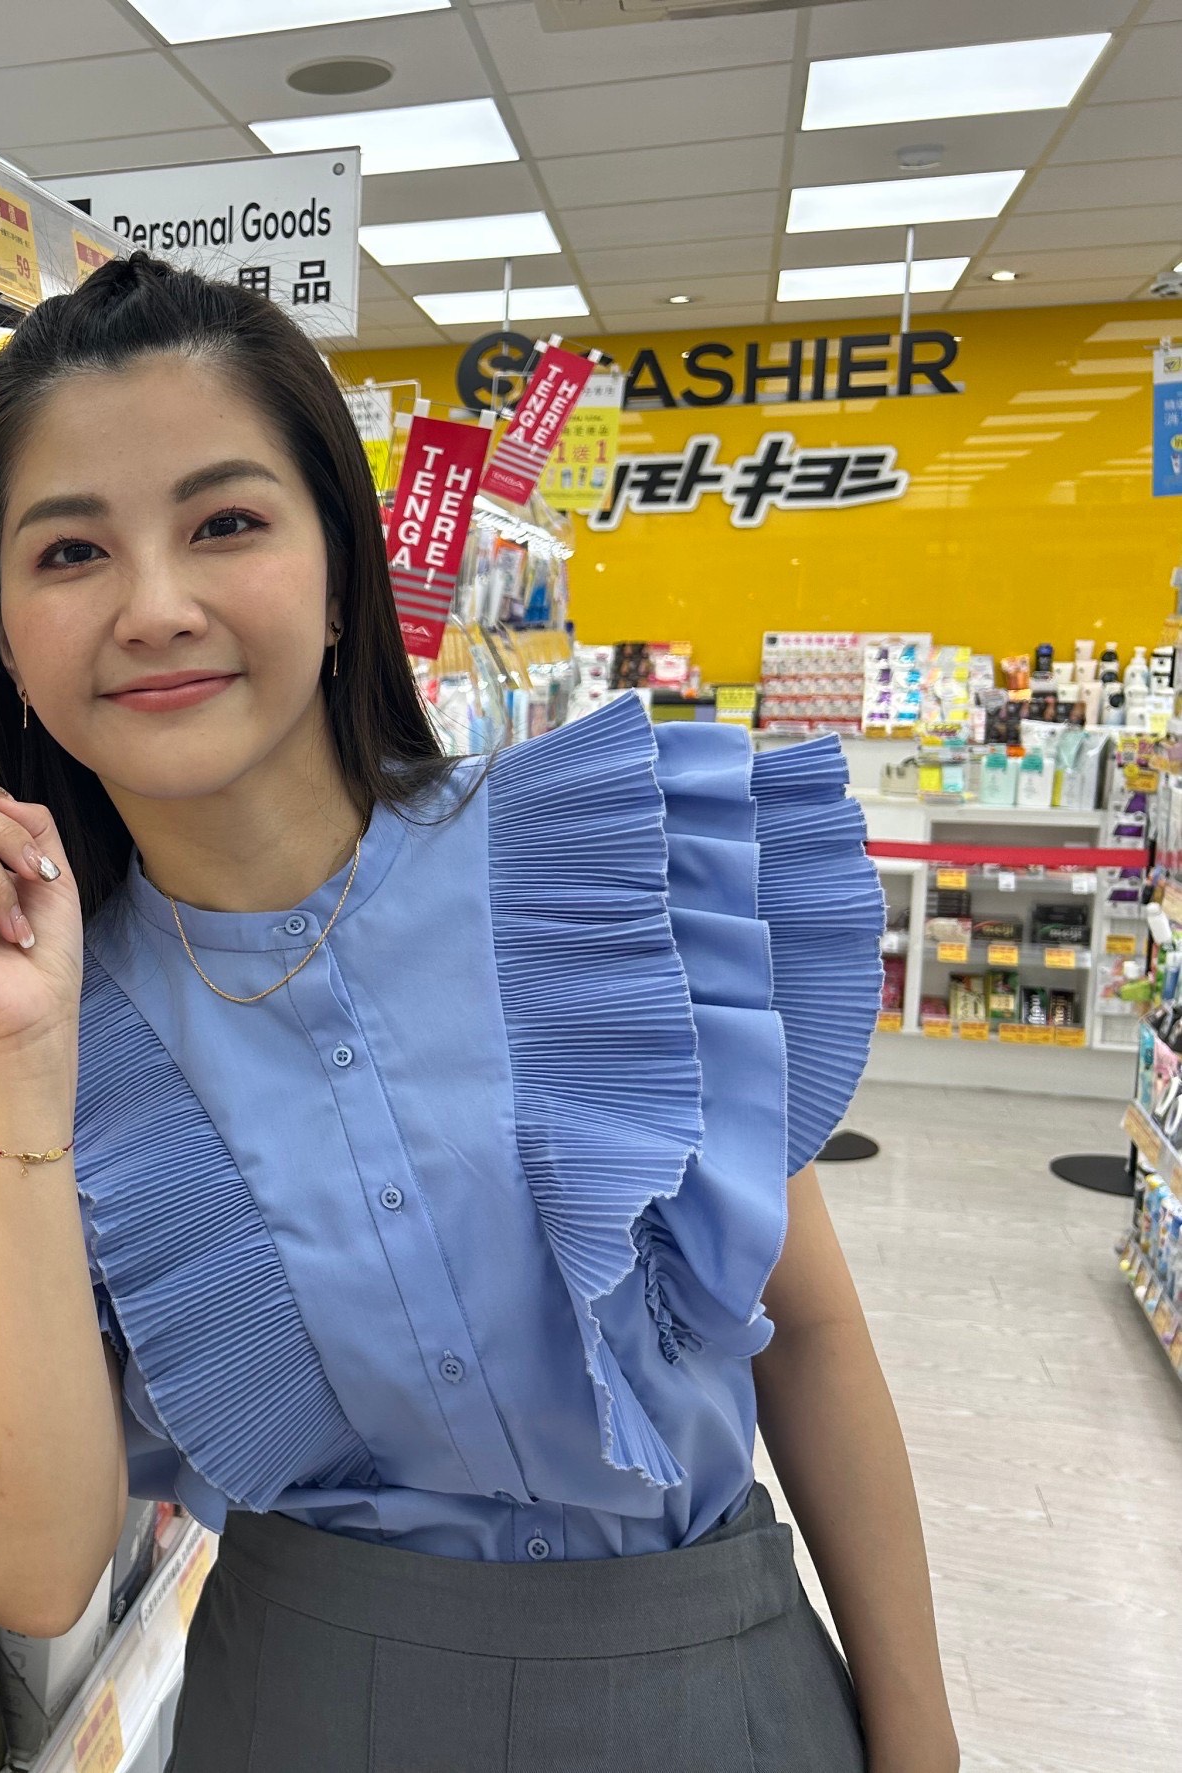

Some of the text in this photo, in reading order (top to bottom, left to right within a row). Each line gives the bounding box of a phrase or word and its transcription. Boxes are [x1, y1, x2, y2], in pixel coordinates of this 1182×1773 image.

[242, 197, 332, 242] Goods
[509, 364, 564, 442] TENGA
[588, 330, 959, 408] ASHIER
[391, 444, 445, 571] TENGA
[423, 464, 472, 590] HERE!
